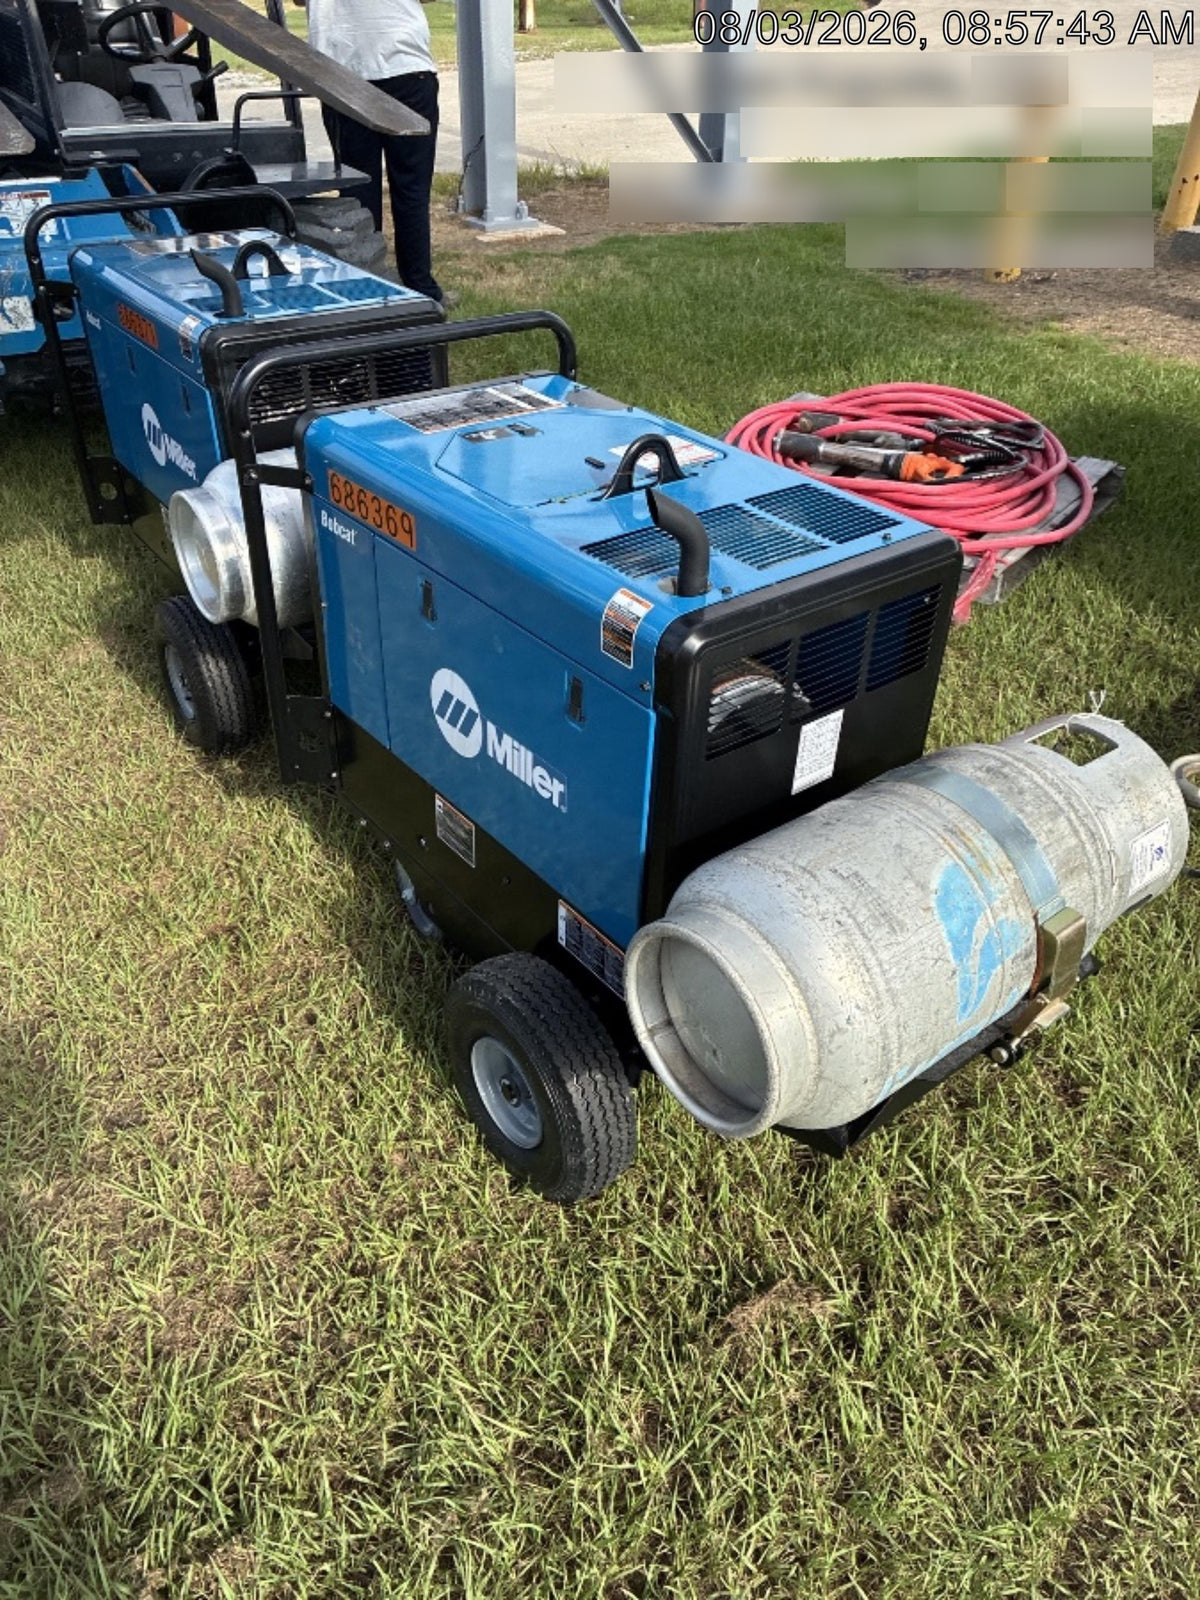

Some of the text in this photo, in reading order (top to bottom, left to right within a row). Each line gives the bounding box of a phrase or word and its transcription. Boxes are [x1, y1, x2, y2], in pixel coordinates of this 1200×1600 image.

[321, 510, 356, 545] Bobcat
[330, 472, 414, 548] 686369
[486, 719, 565, 809] Miller
